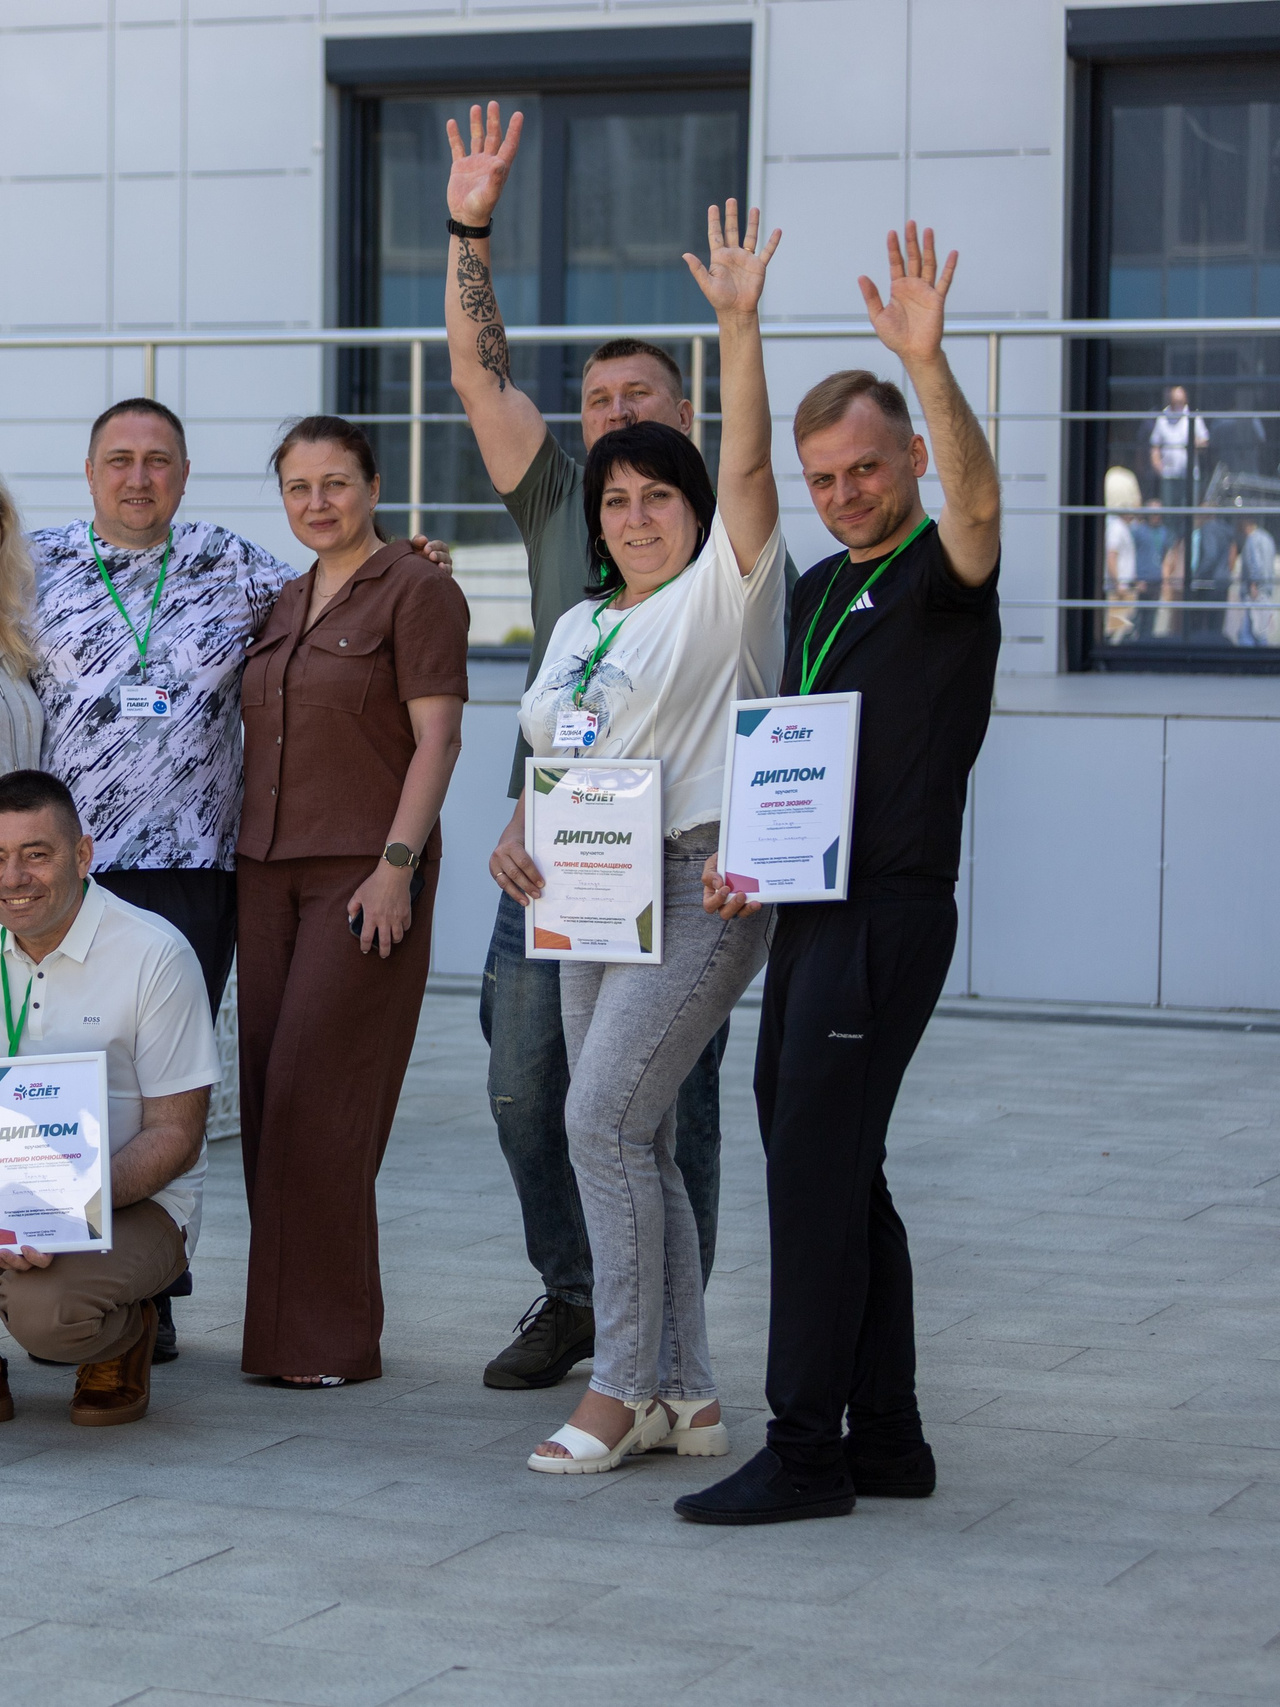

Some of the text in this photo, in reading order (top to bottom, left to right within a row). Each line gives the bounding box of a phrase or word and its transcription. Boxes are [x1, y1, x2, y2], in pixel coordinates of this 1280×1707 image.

[784, 727, 813, 740] СЛЁТ
[750, 766, 826, 787] ДИПЛОМ
[585, 791, 616, 802] СЛЁТ
[553, 830, 632, 845] ДИПЛОМ
[28, 1085, 60, 1097] СЛЁТ
